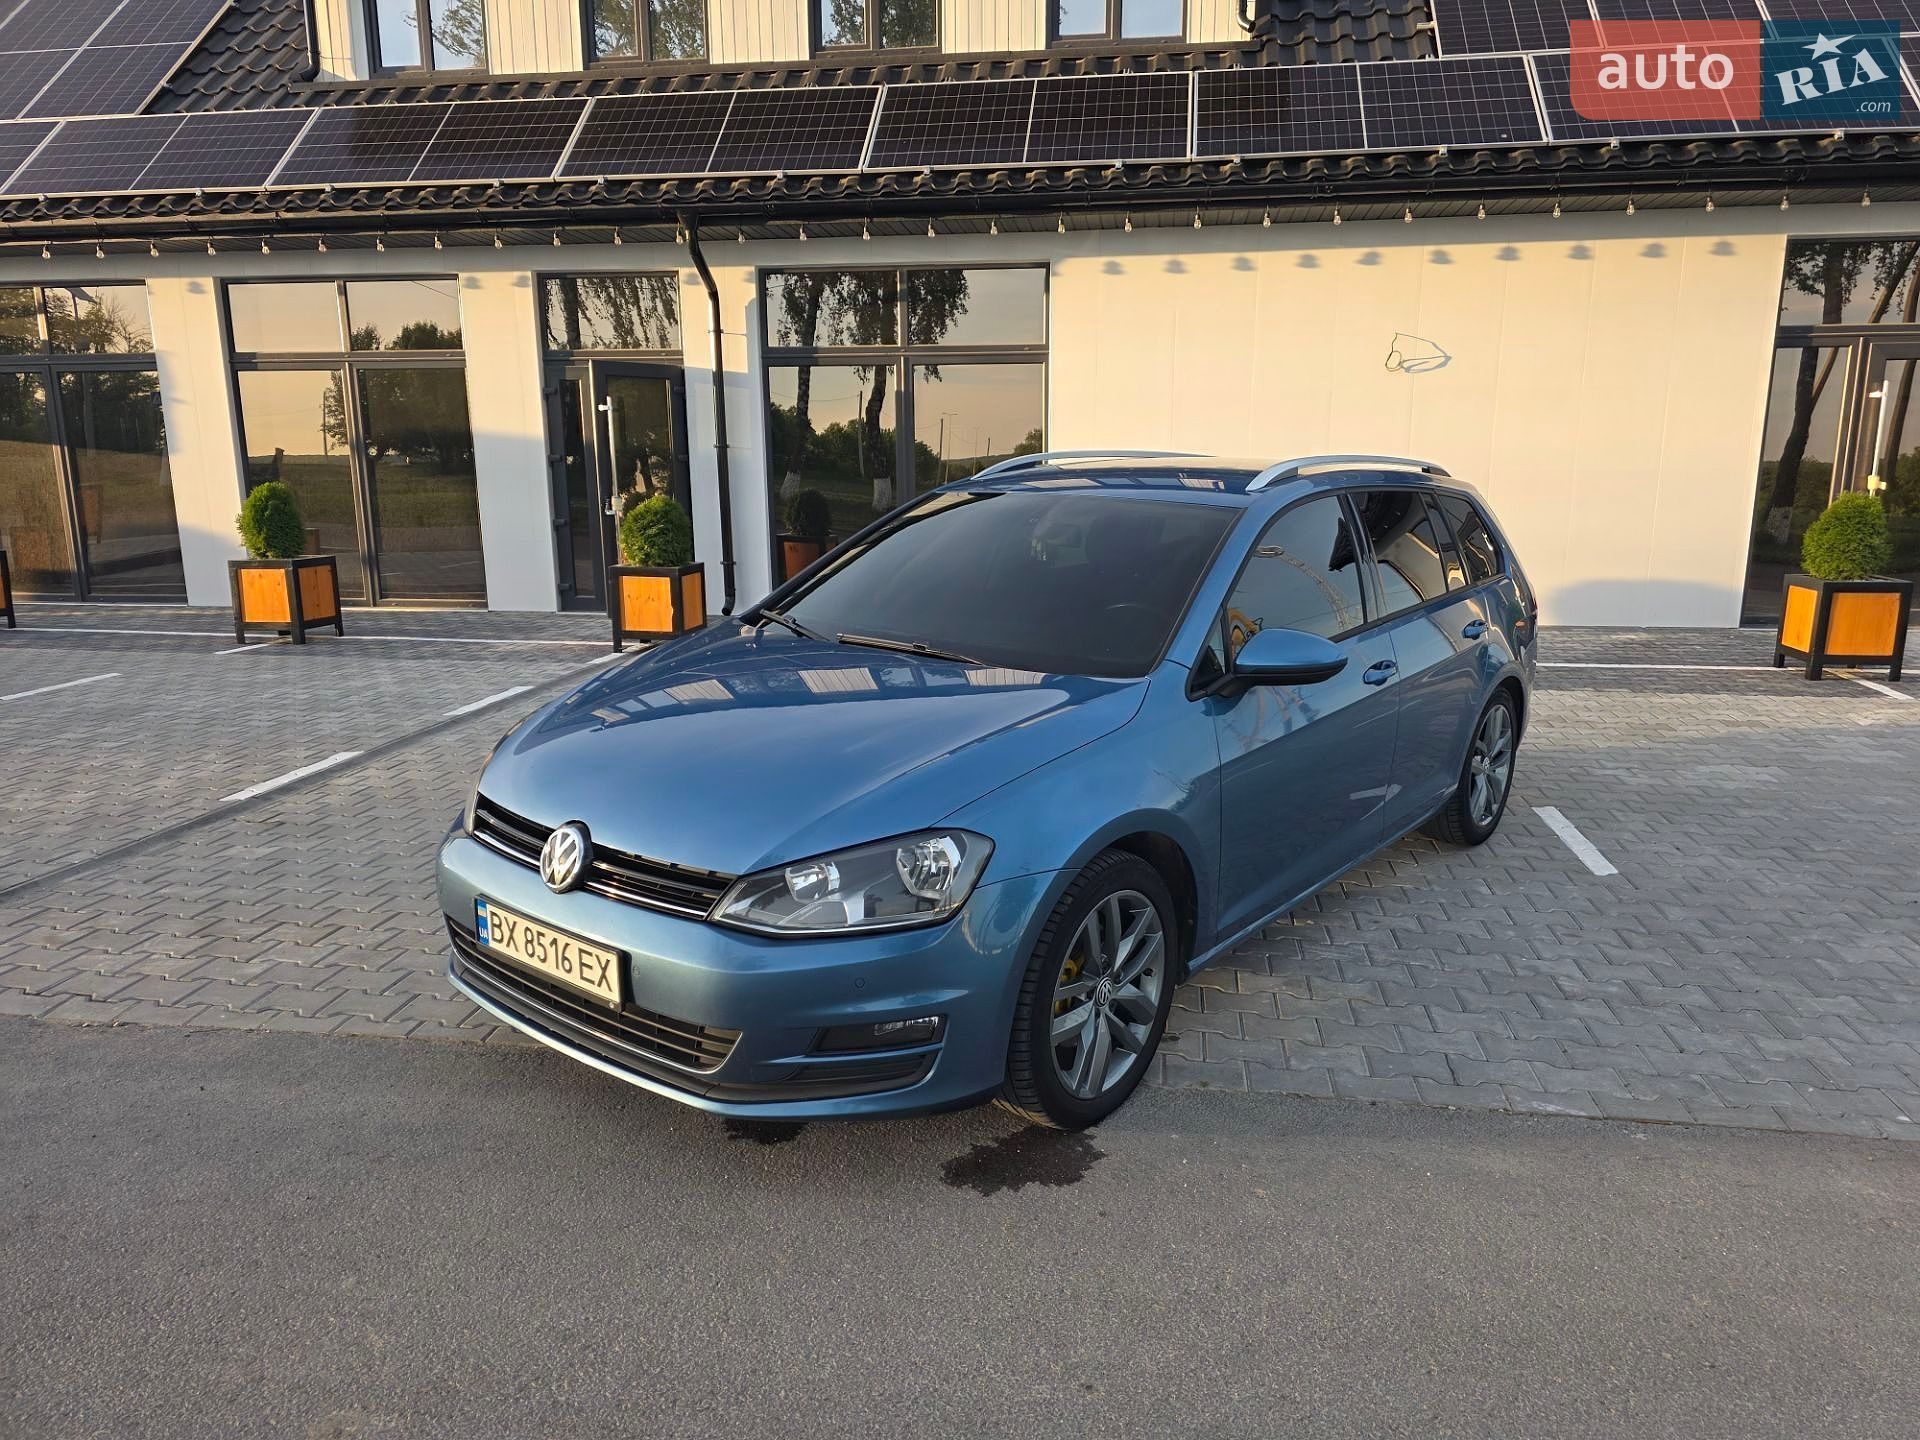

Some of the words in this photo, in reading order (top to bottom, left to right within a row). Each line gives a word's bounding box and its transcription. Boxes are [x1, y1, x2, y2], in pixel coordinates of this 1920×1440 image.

[478, 927, 489, 940] UA
[489, 910, 519, 953] BX
[523, 926, 574, 975] 8516
[578, 947, 613, 993] EX
